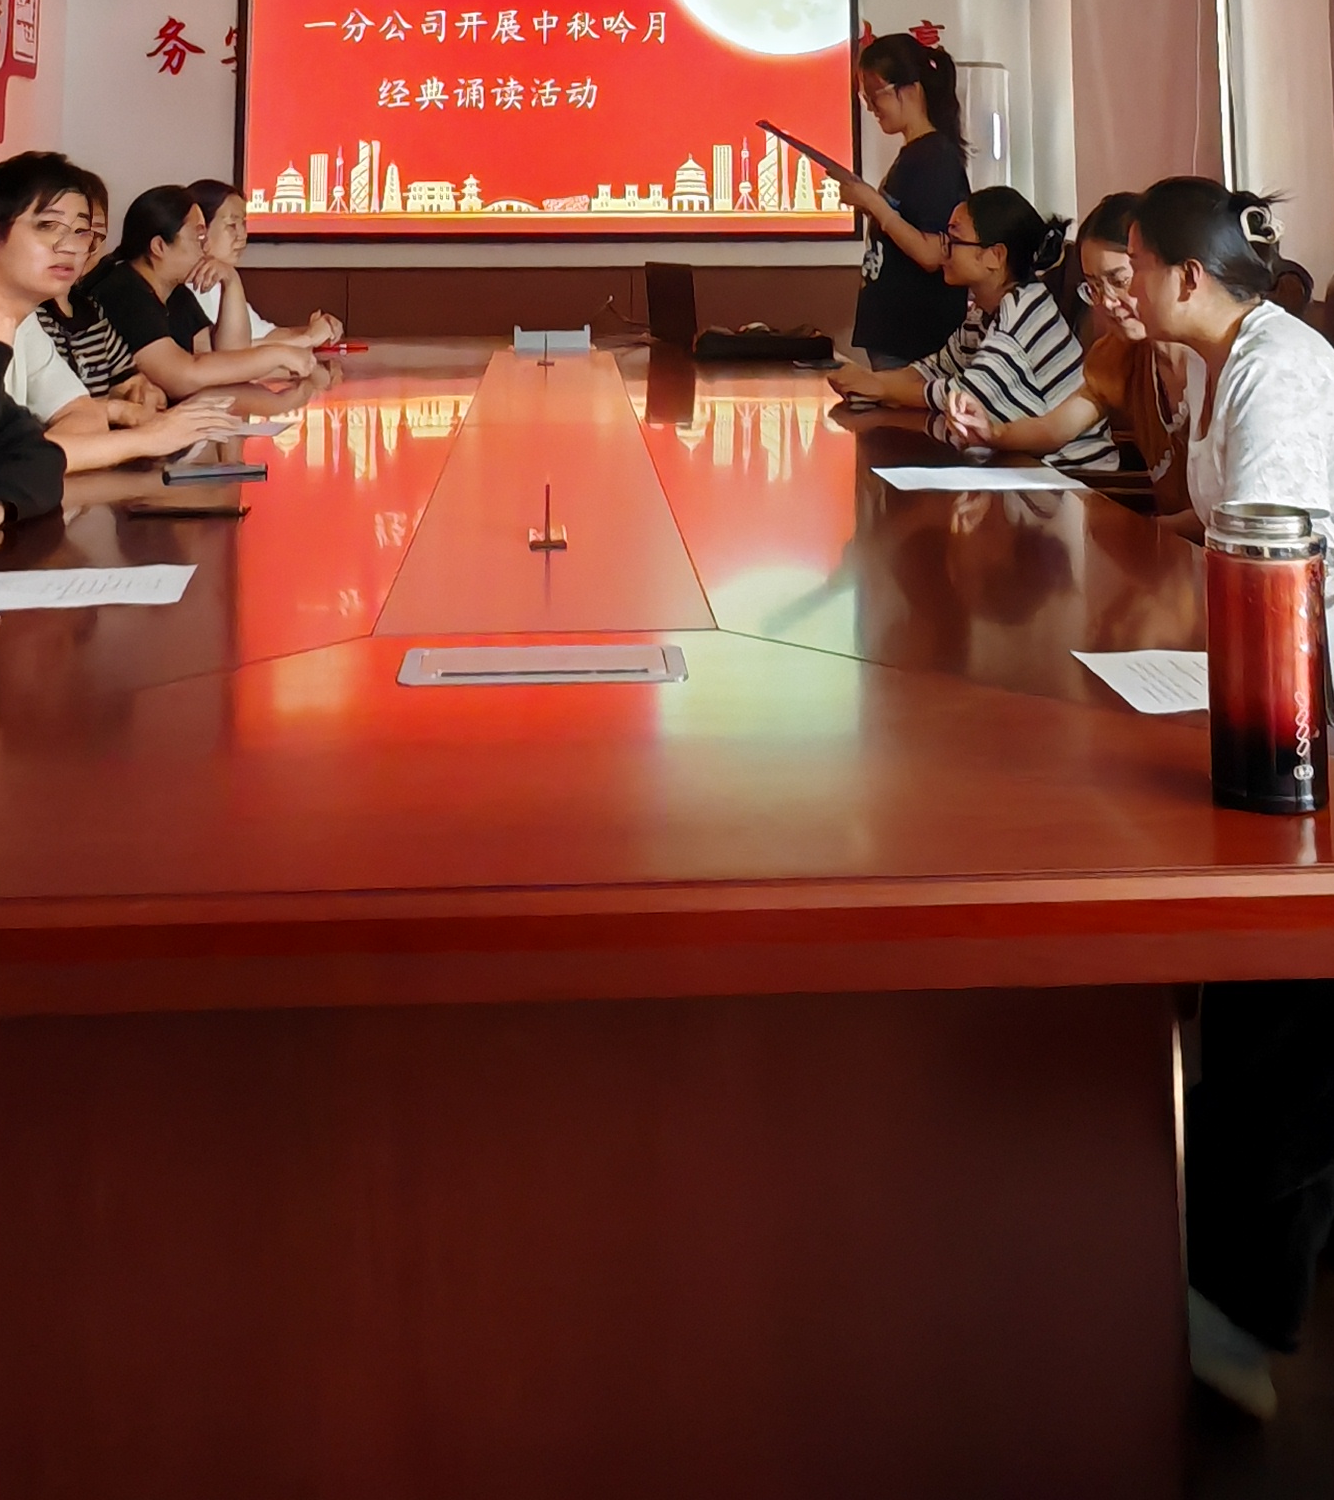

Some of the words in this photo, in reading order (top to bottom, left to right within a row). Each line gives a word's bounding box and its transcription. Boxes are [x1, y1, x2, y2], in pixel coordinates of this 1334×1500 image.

[303, 8, 667, 45] 一分公司开展中秋吟月
[376, 76, 599, 112] 经典诵读活动
